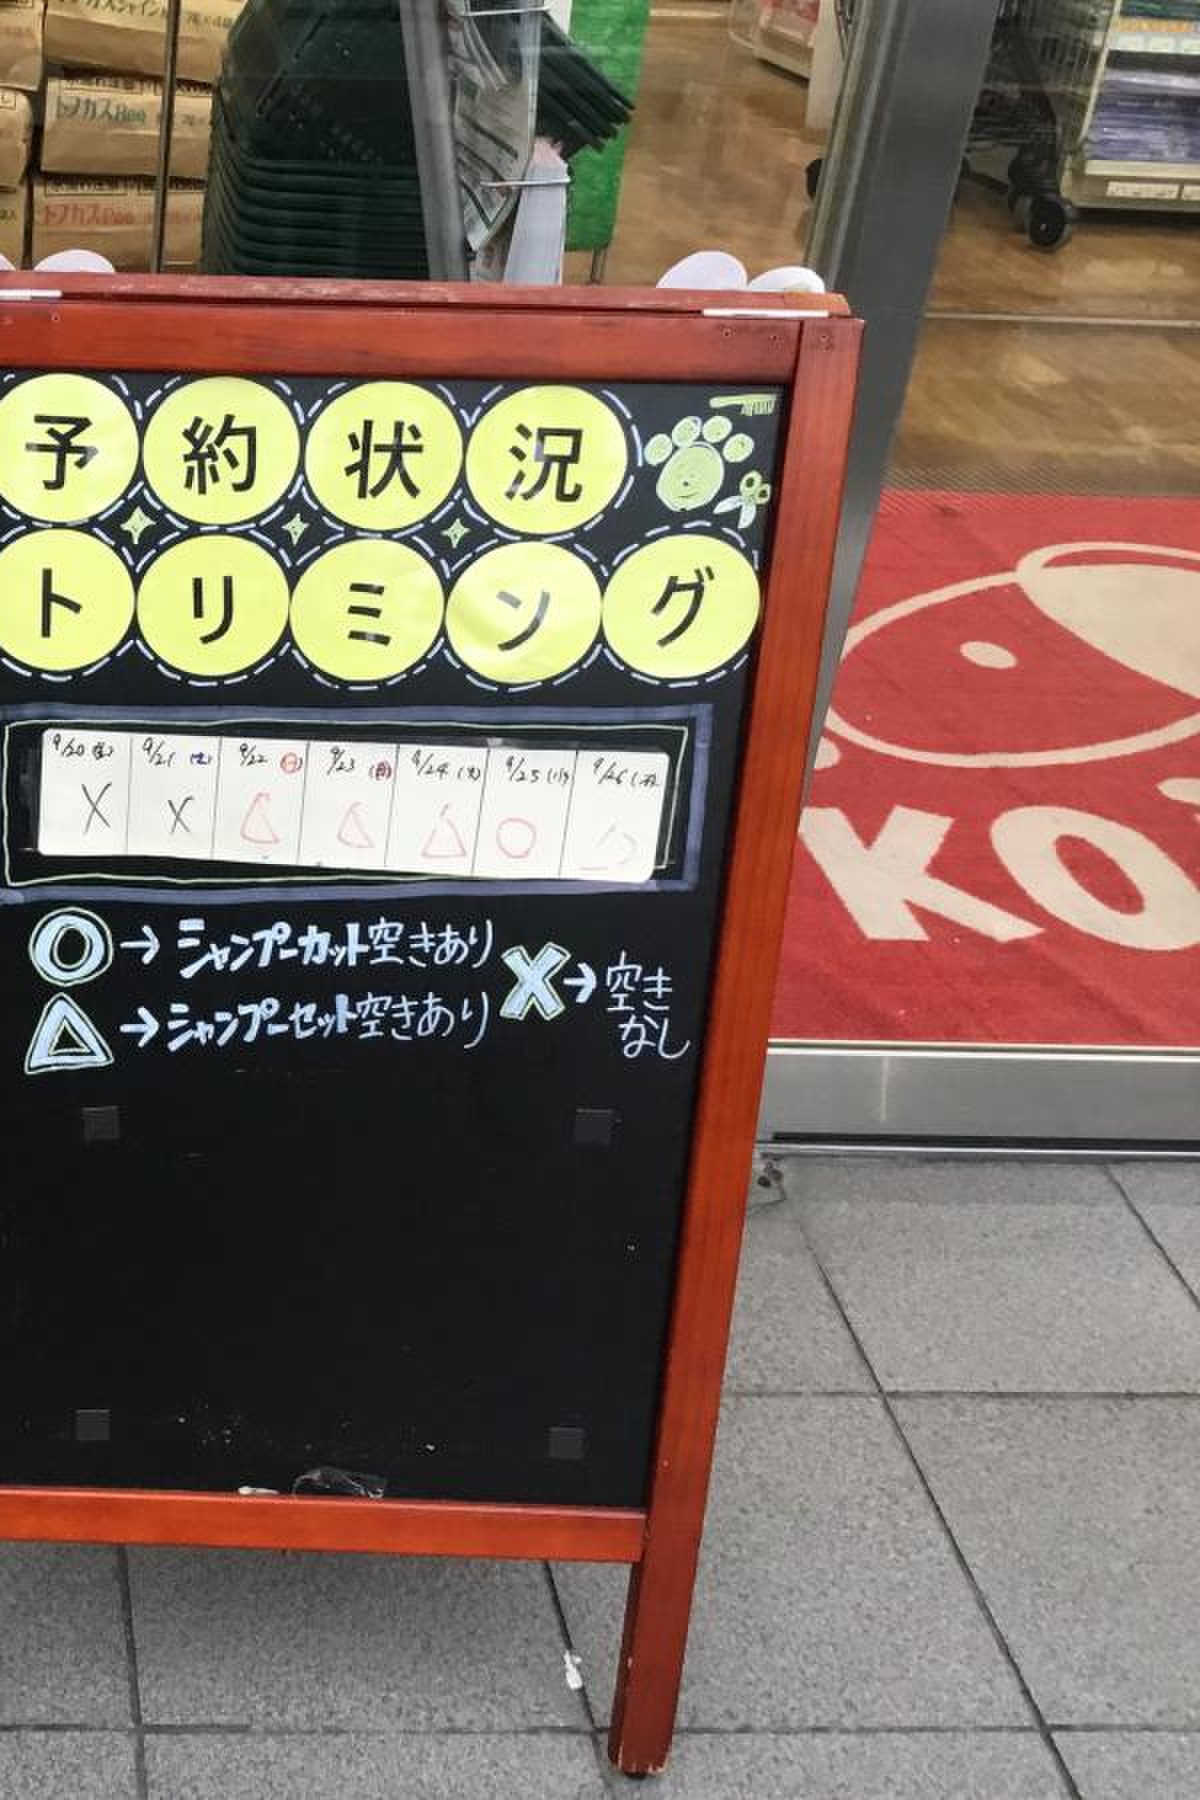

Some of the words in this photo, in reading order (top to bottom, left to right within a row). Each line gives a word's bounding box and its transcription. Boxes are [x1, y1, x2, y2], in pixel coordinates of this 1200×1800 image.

[24, 415, 584, 503] 予約状況
[40, 566, 715, 652] トリミング
[239, 743, 269, 766] 9/22
[177, 917, 496, 980] シャンプーカット空きあり
[605, 951, 674, 1012] 空き
[167, 991, 490, 1053] シャンプーセット空きあり
[619, 1017, 690, 1059] なし
